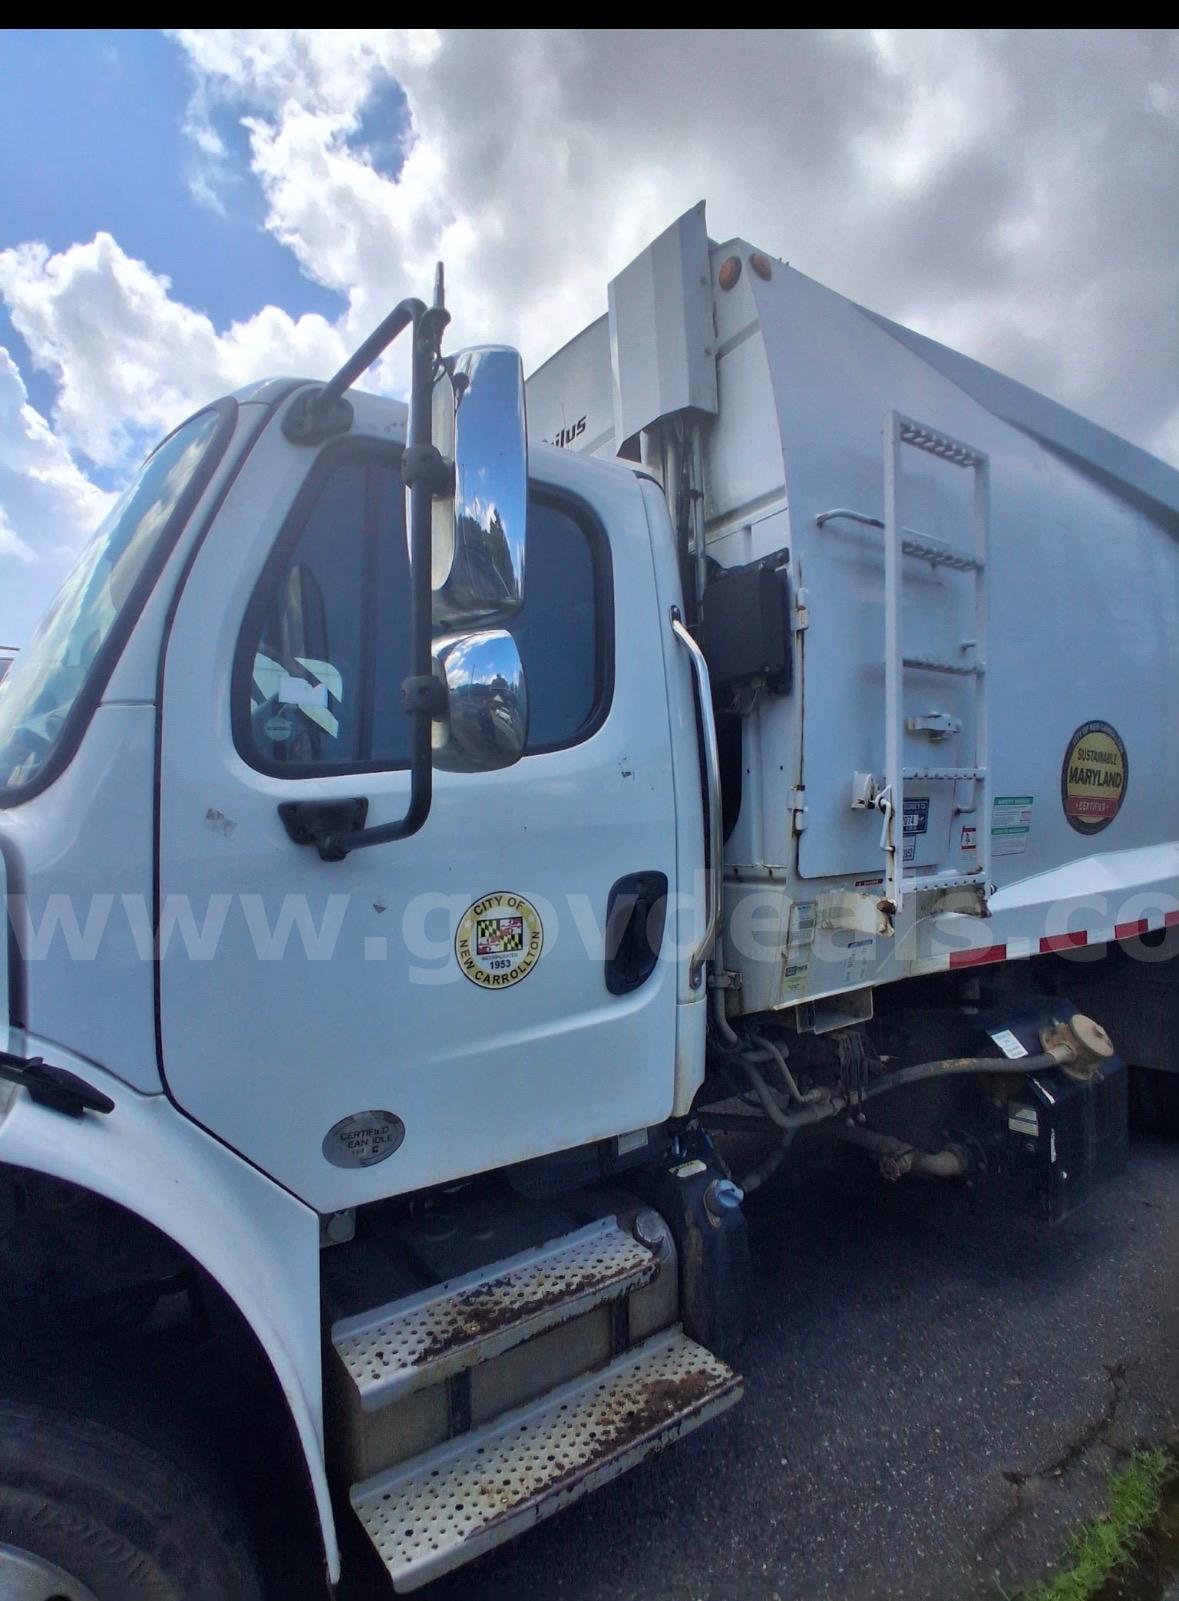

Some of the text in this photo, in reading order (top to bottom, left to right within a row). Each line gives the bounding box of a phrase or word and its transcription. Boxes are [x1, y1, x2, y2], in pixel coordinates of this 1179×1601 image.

[542, 415, 587, 448] ilus
[1068, 766, 1122, 788] MARYLAND
[473, 896, 525, 916] CITY OF
[459, 931, 541, 985] NEW CARROLLTON
[489, 959, 511, 970] 1953
